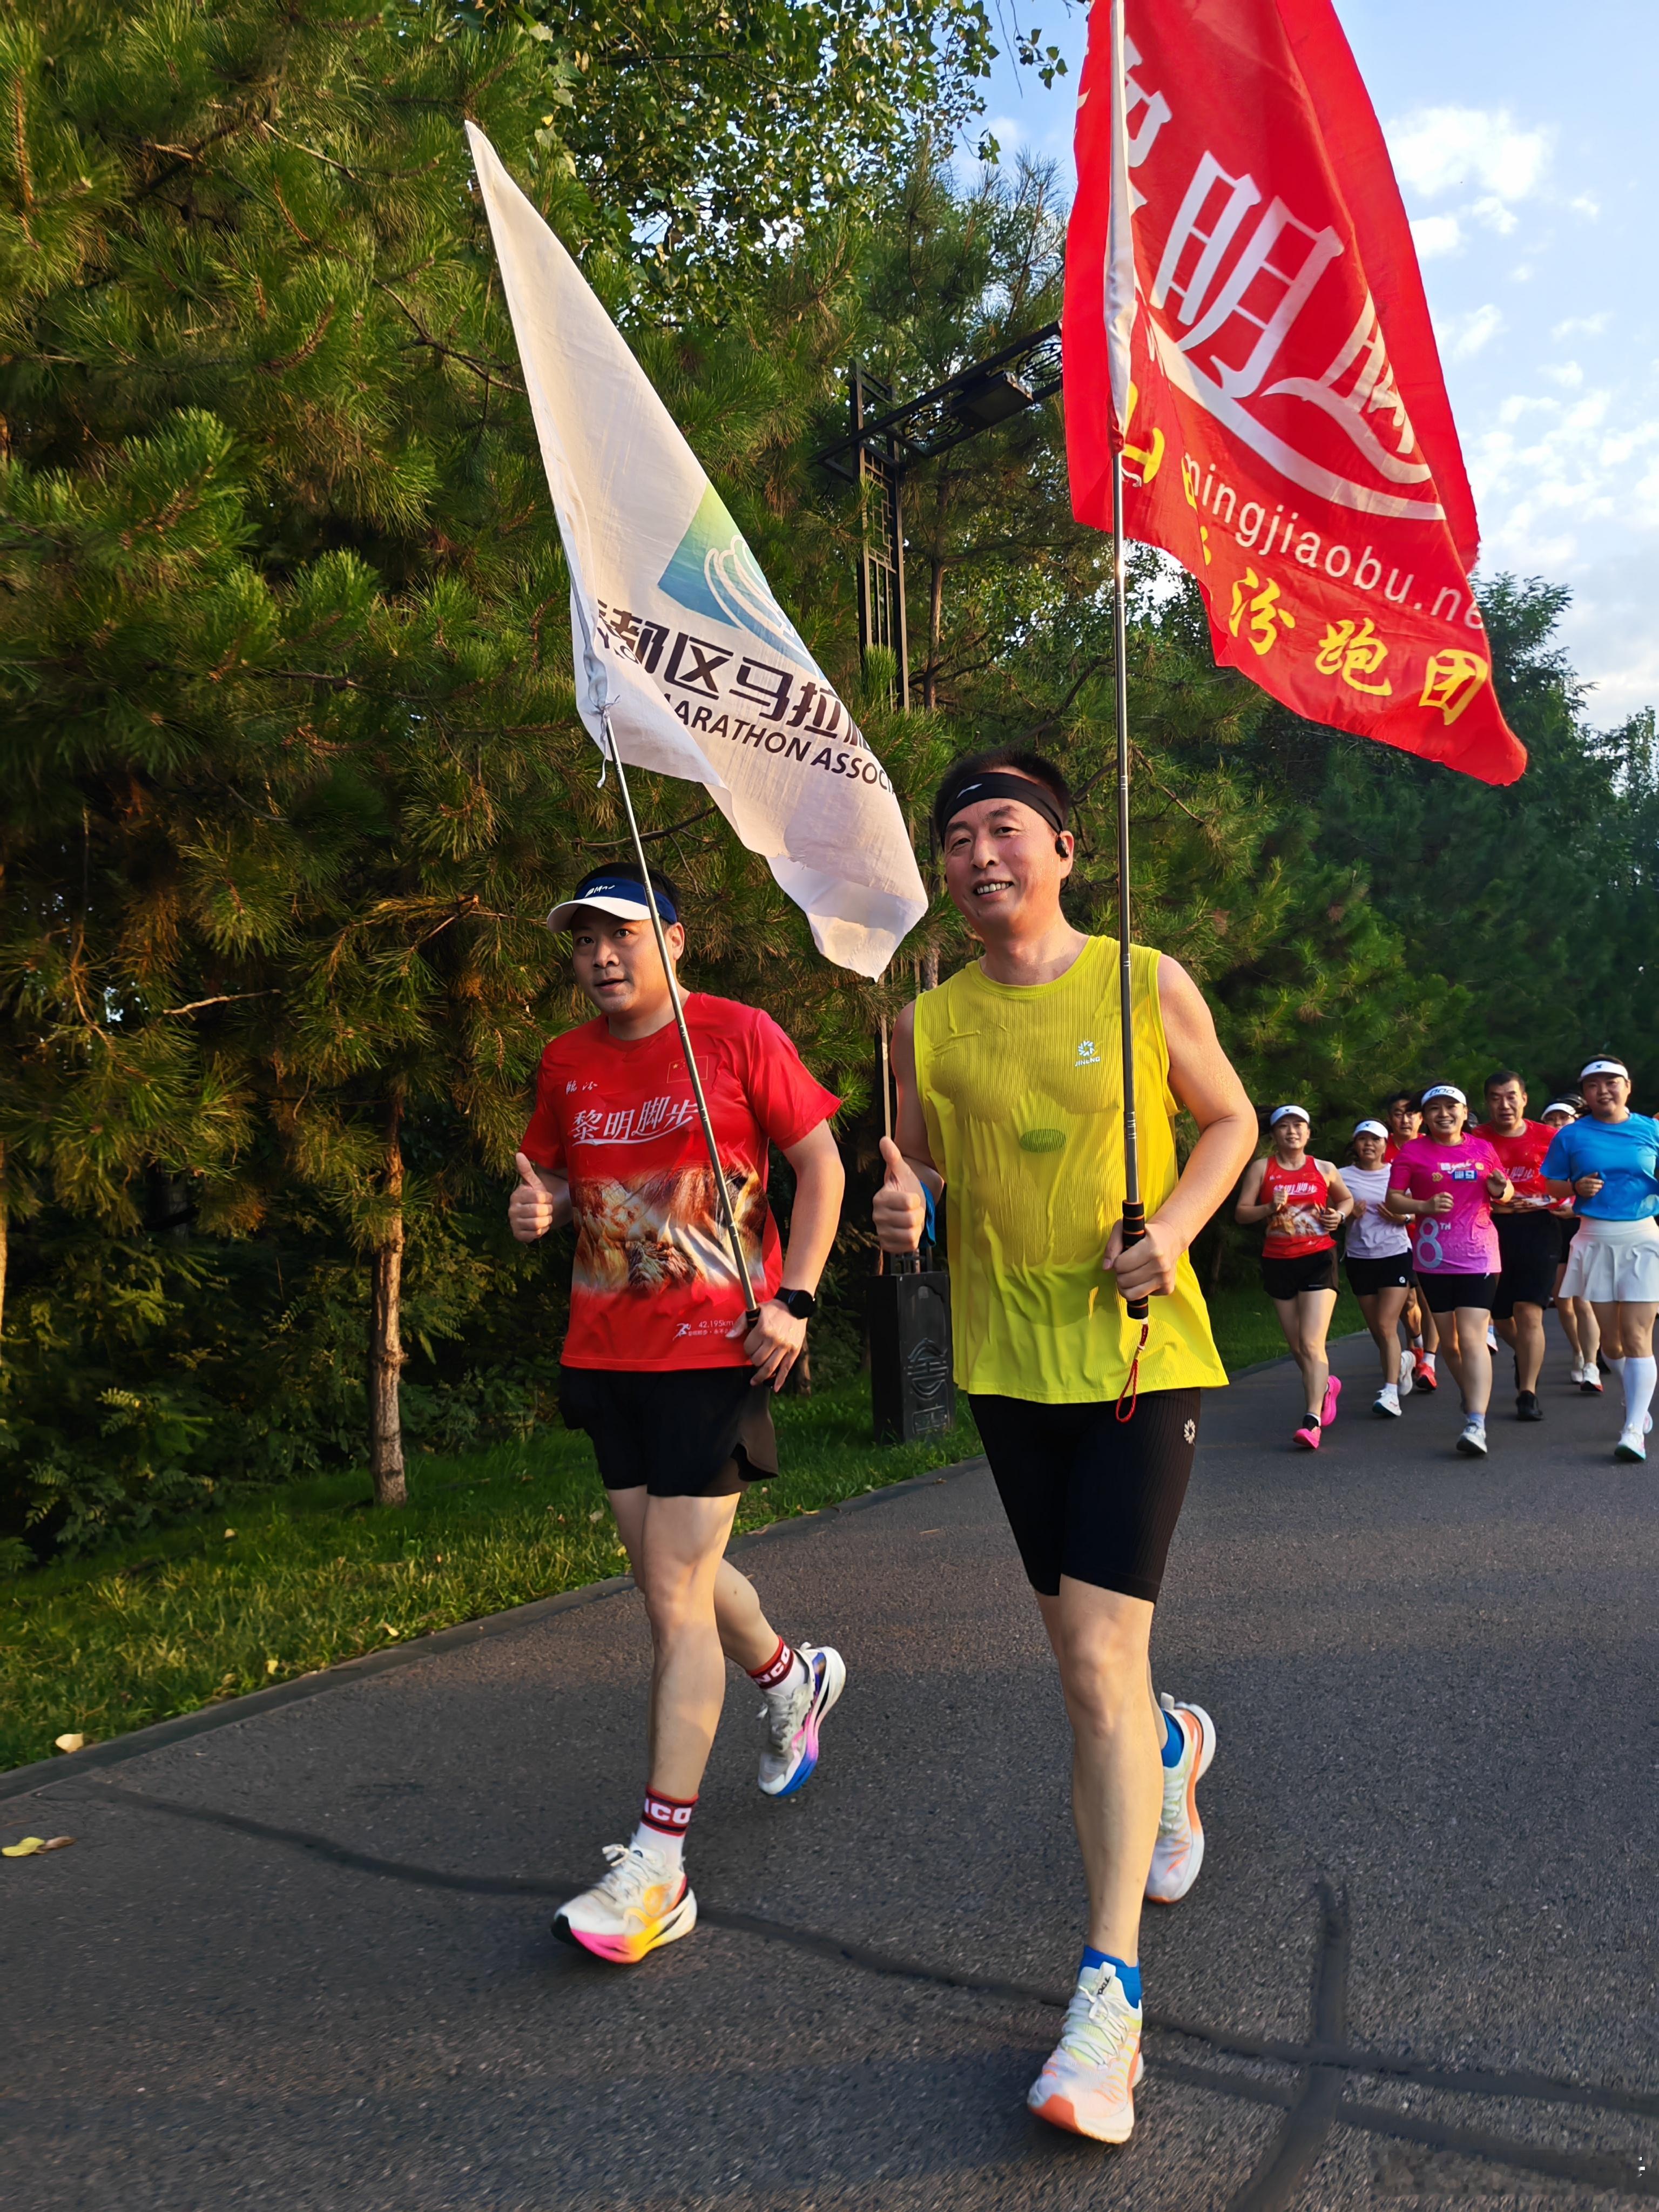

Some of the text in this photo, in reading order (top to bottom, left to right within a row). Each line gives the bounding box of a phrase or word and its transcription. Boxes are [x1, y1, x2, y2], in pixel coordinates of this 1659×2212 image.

[597, 598, 872, 753] 都区马拉
[1200, 525, 1488, 725] 汾跑团
[664, 693, 894, 795] ARATHON ASSOCI
[571, 1096, 699, 1143] 黎明脚步
[698, 1319, 734, 1328] 42.195km
